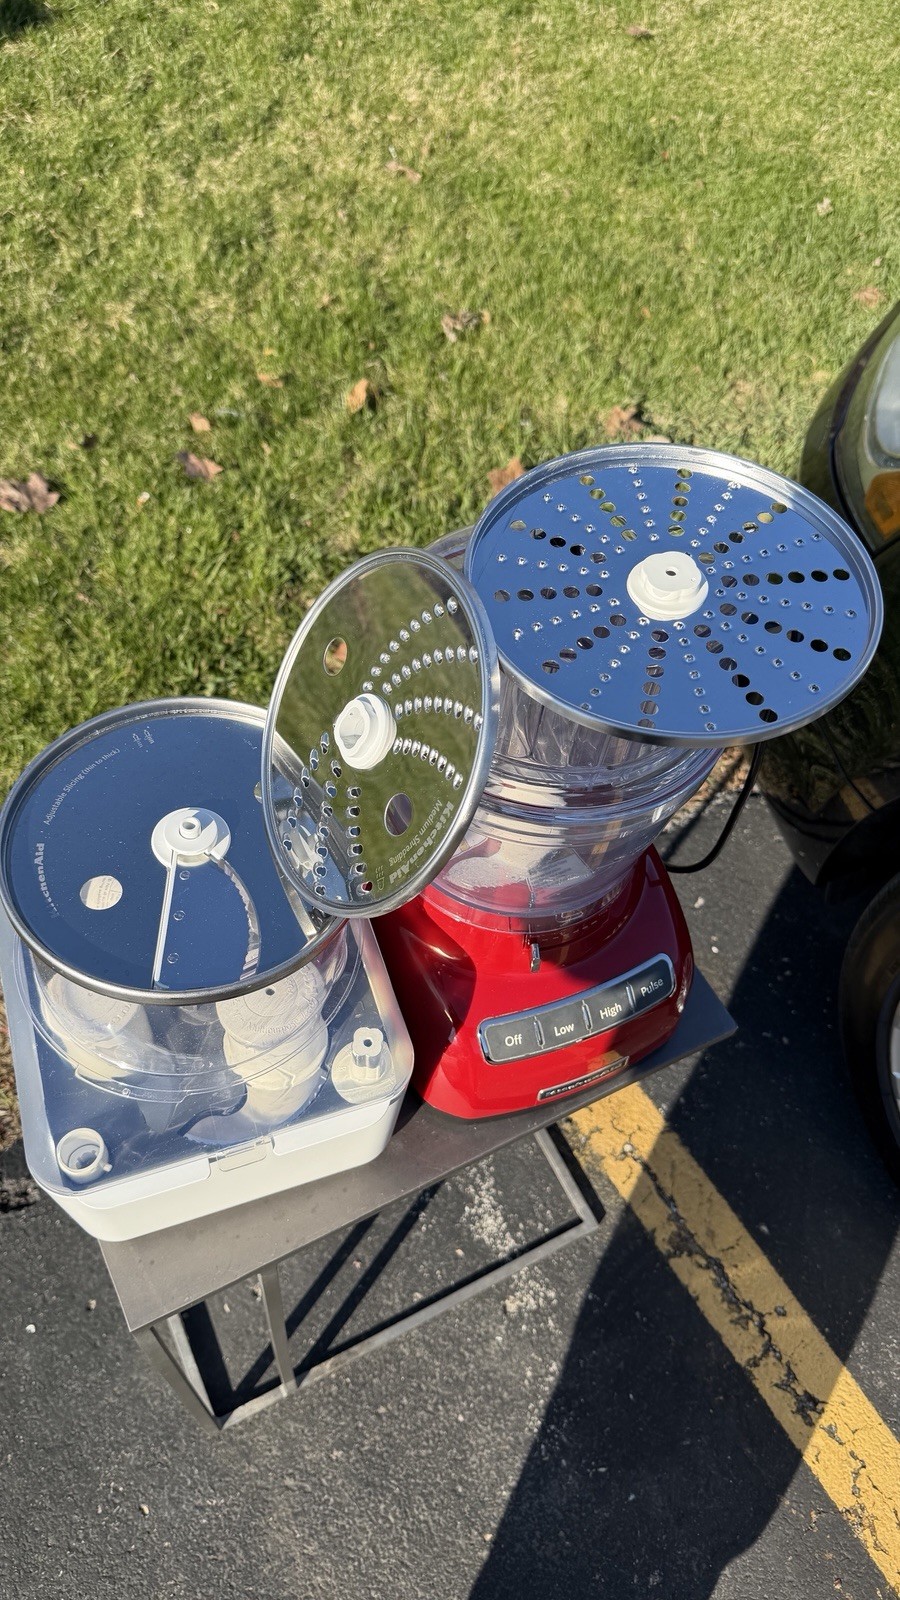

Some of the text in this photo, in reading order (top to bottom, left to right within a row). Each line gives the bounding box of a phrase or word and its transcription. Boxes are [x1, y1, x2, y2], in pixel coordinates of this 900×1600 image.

[43, 792, 67, 825] Adjustable
[63, 773, 85, 792] Slicing
[82, 763, 97, 775] (thin
[102, 746, 120, 761] thick)
[388, 799, 443, 866] Medium Shredding
[389, 801, 454, 884] KitchenAid
[34, 843, 60, 918] chenAid
[504, 977, 664, 1047] Off Low High Pulse
